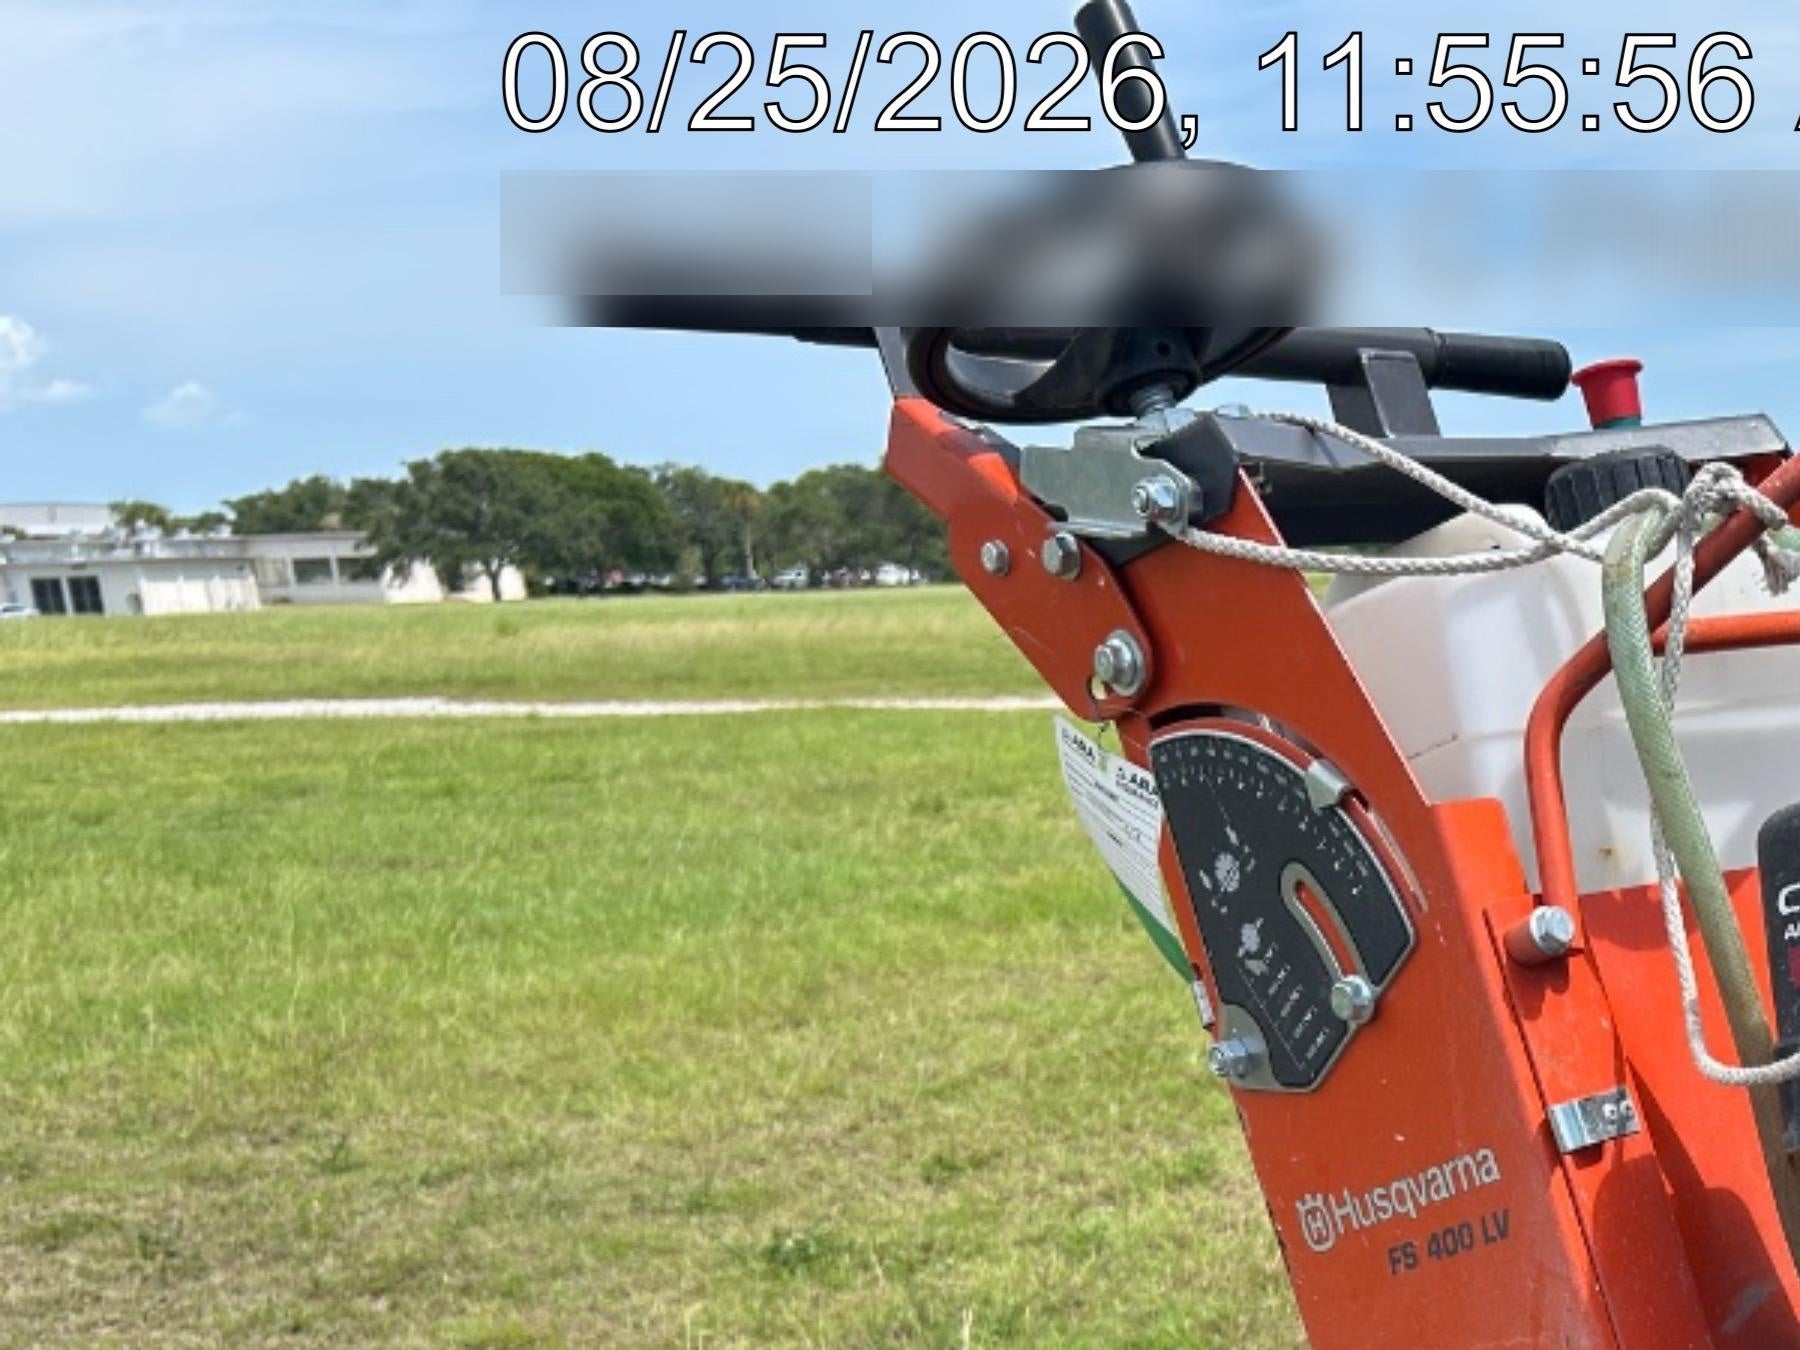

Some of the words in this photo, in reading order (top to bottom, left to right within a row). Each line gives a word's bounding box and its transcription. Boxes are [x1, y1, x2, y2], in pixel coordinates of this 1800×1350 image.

[1328, 1148, 1500, 1234] Husqvarna
[1388, 1241, 1418, 1275] FS
[1427, 1222, 1474, 1260] 400
[1481, 1208, 1510, 1245] LV
